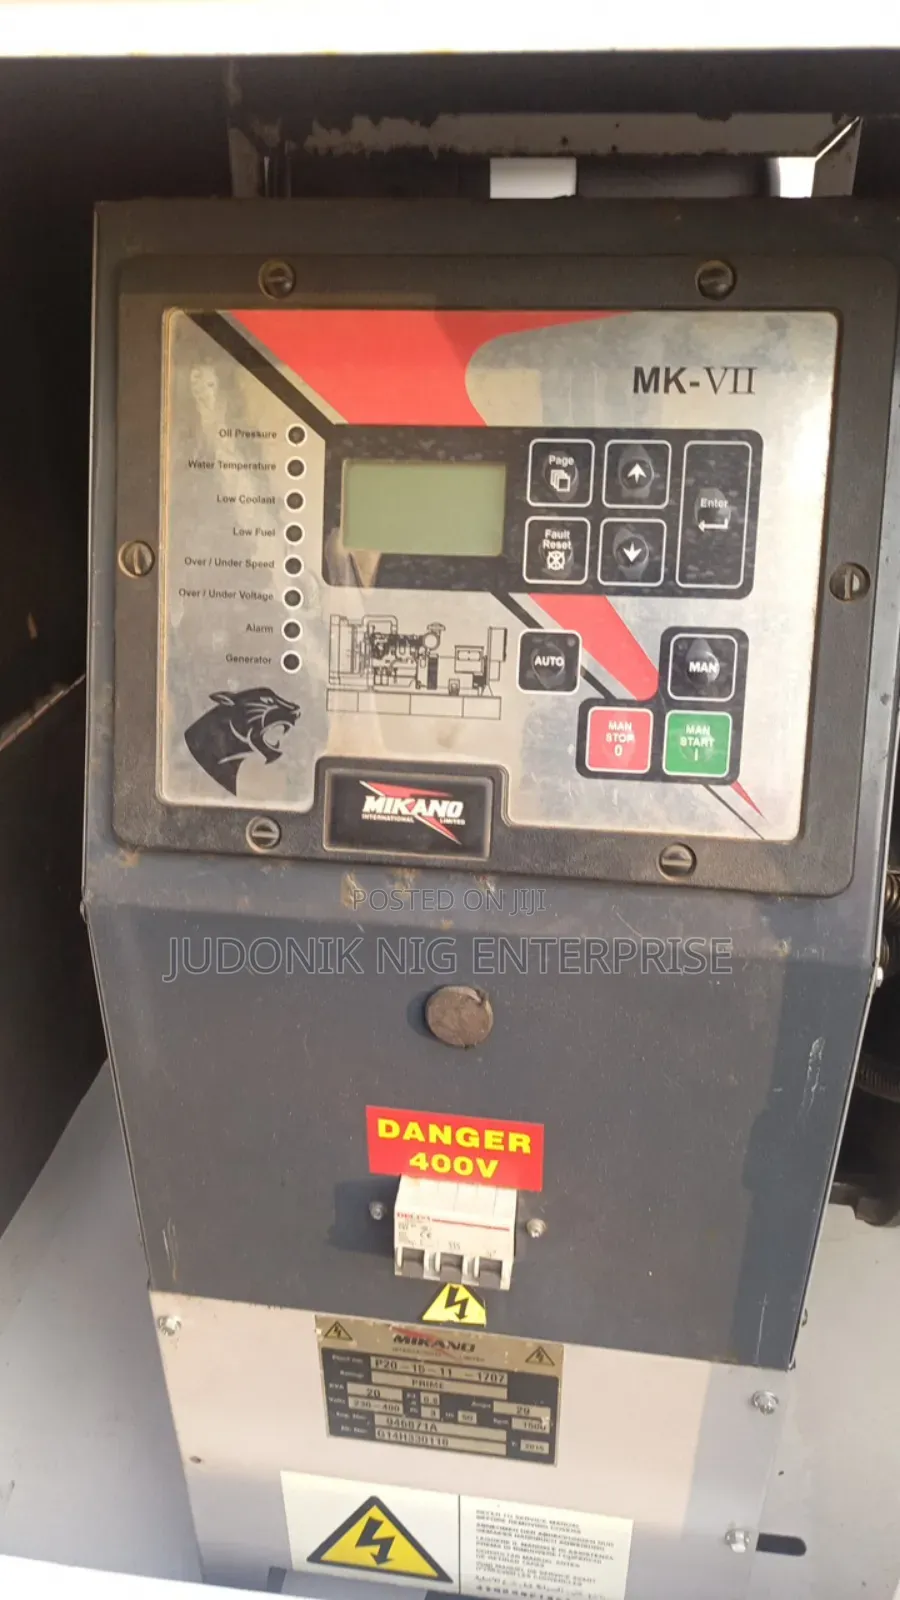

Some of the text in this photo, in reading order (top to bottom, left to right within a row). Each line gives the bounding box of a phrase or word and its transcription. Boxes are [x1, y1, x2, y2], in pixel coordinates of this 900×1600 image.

[632, 366, 758, 396] MK-VII
[218, 429, 277, 440] Oil Pressure
[187, 459, 277, 472] Water Temperature
[548, 455, 575, 467] Page
[216, 494, 276, 505] Low Coolant
[700, 497, 729, 508] Enter
[232, 527, 276, 537] Low Fuel
[544, 529, 571, 540] Fault
[542, 539, 572, 550] Reset
[184, 557, 207, 567] Over
[213, 557, 242, 568] Under
[244, 559, 275, 570] Speed
[178, 588, 201, 598] Over
[208, 589, 236, 600] Under
[239, 590, 274, 602] Voltage
[245, 624, 274, 634] Alarm
[225, 654, 272, 665] Generator
[534, 656, 565, 667] AUTO
[688, 661, 719, 673] MAN
[608, 720, 633, 731] MAN
[685, 724, 710, 735] MAN
[605, 732, 635, 744] STOP
[679, 736, 716, 748] START
[362, 795, 464, 819] MIKANO
[361, 813, 466, 826] INTERNATIONAL LIMITED
[377, 1117, 532, 1155] DANGER
[409, 1152, 500, 1179] 400V
[392, 1334, 476, 1353] MIKANO
[411, 1379, 445, 1390] PRIME
[366, 1388, 380, 1398] 20
